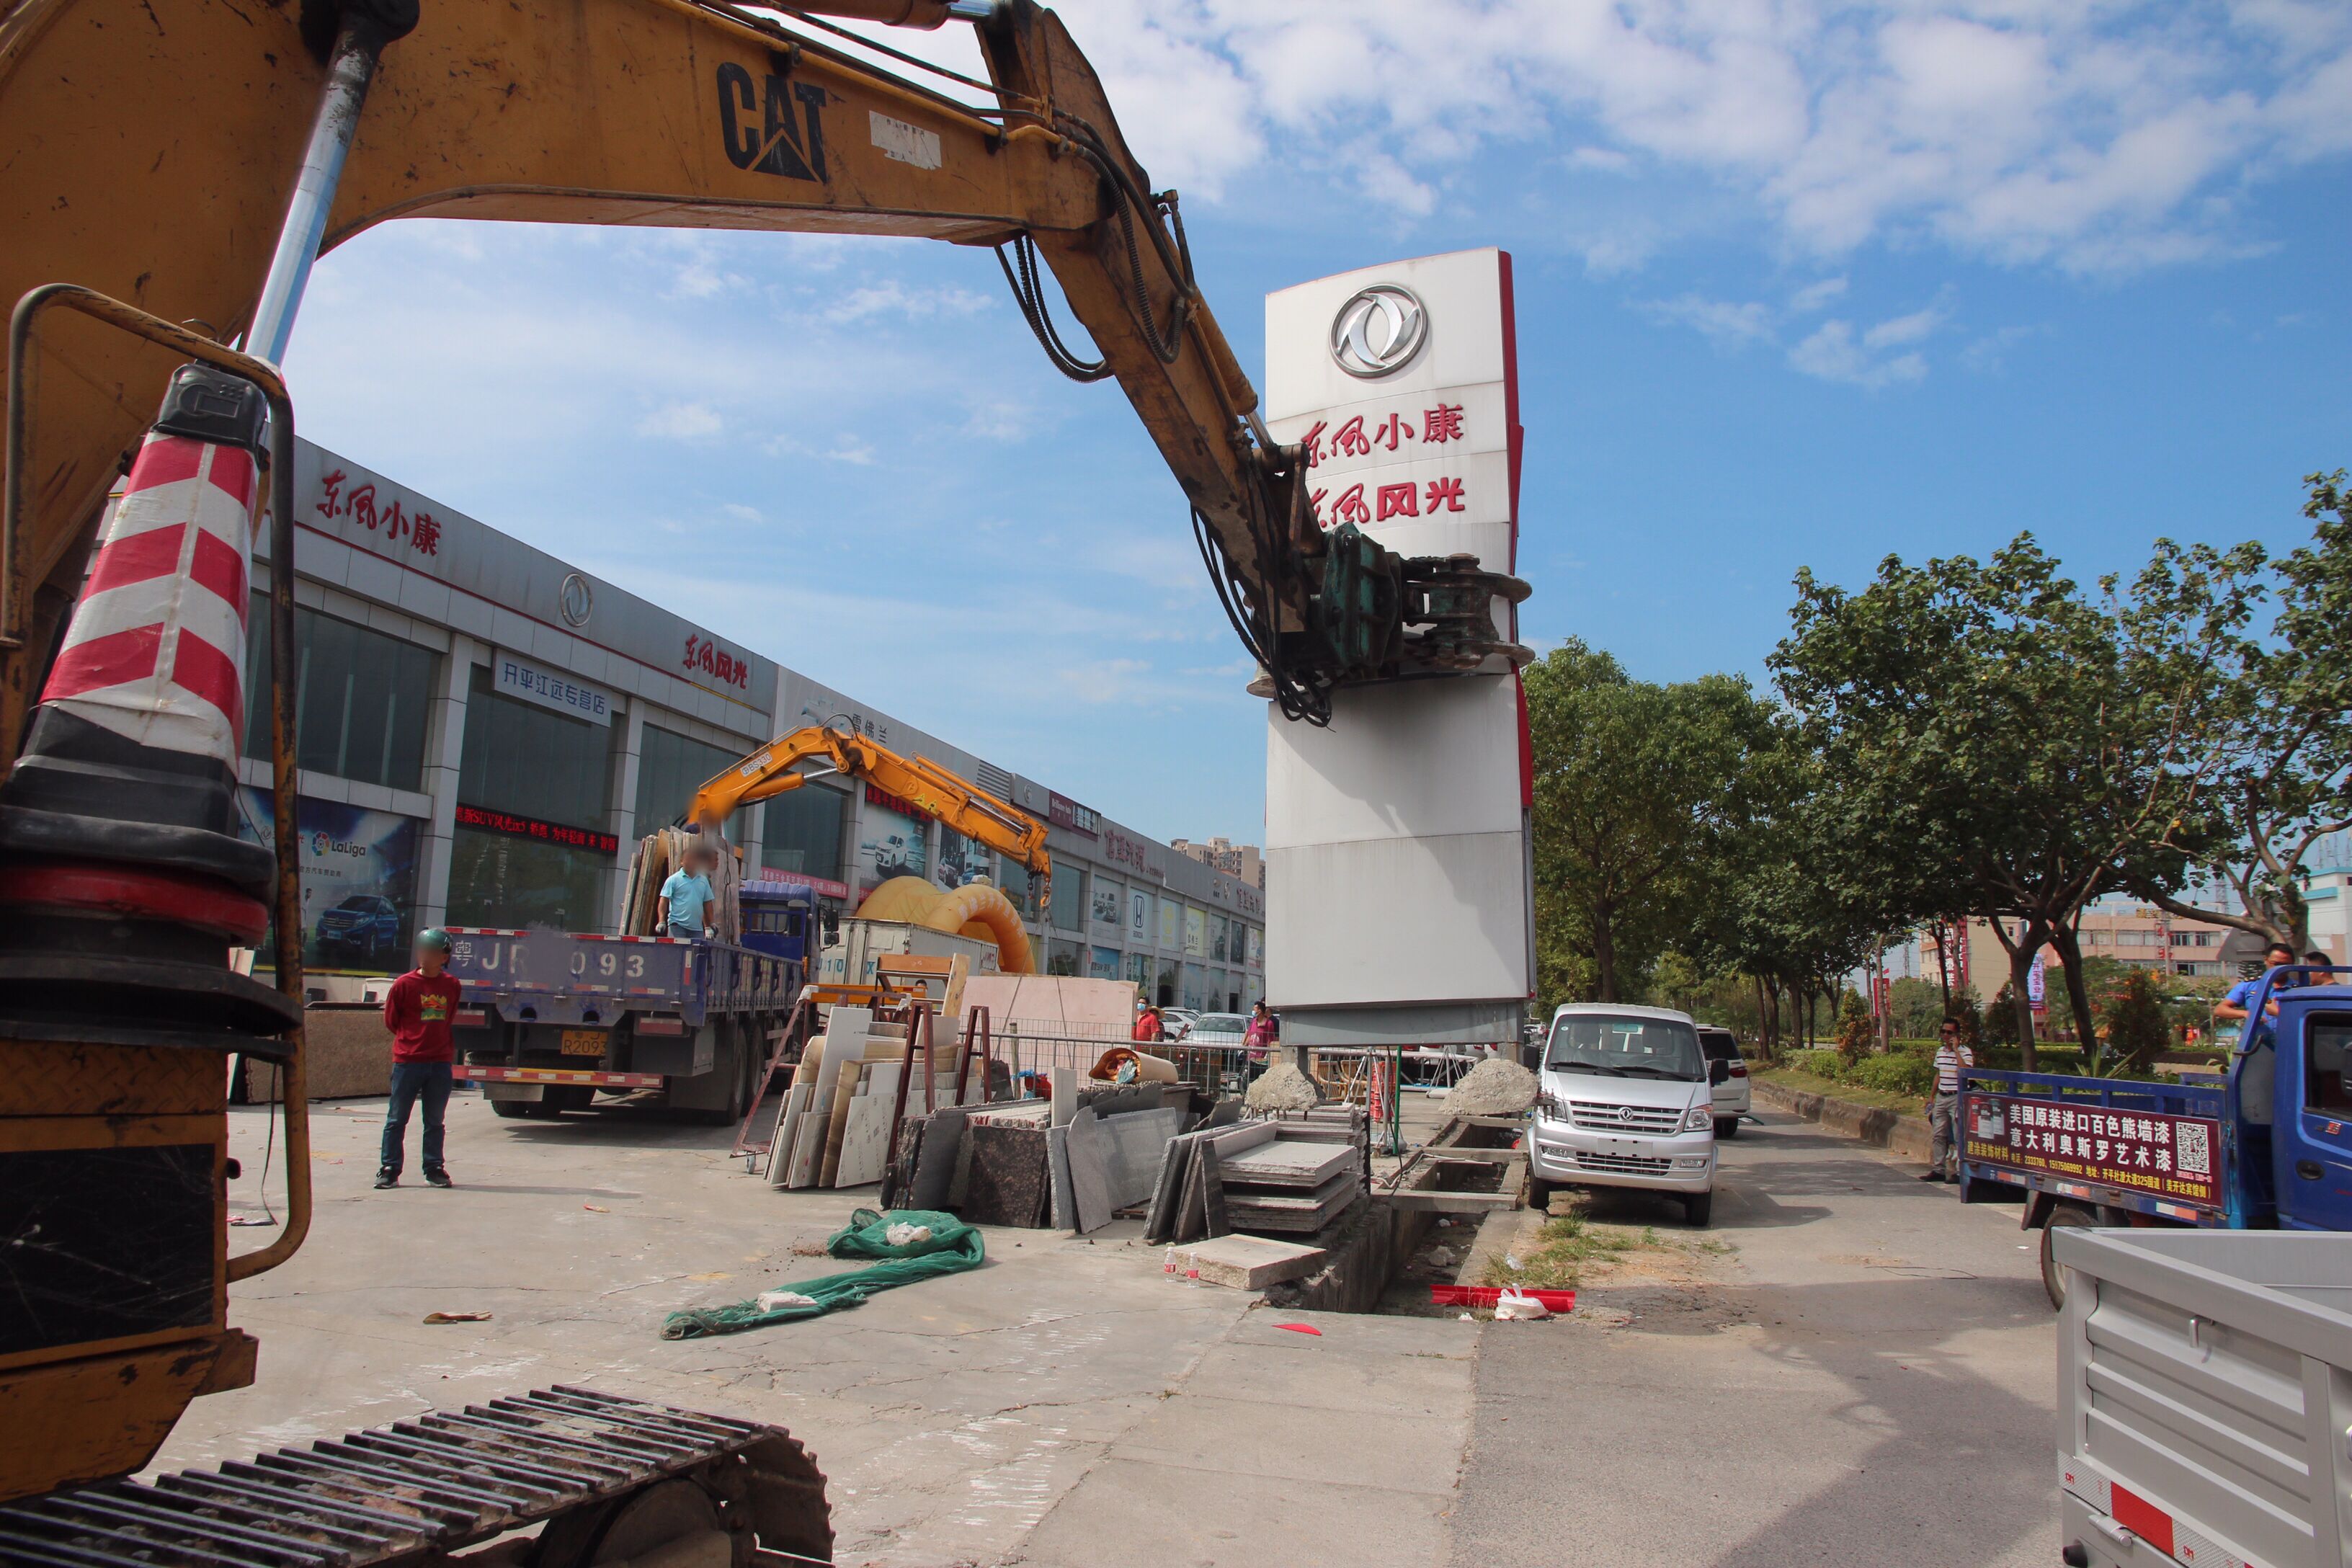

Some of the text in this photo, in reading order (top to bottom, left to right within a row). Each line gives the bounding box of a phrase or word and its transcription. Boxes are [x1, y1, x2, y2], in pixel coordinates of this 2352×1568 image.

[717, 62, 827, 184] CAT
[504, 662, 605, 715] 开平江远专营店
[331, 840, 366, 858] LaLiga
[2010, 1103, 2170, 1144] 美国原装进口百色熊墙漆
[2010, 1127, 2172, 1172] 意大利奥斯罗艺术漆
